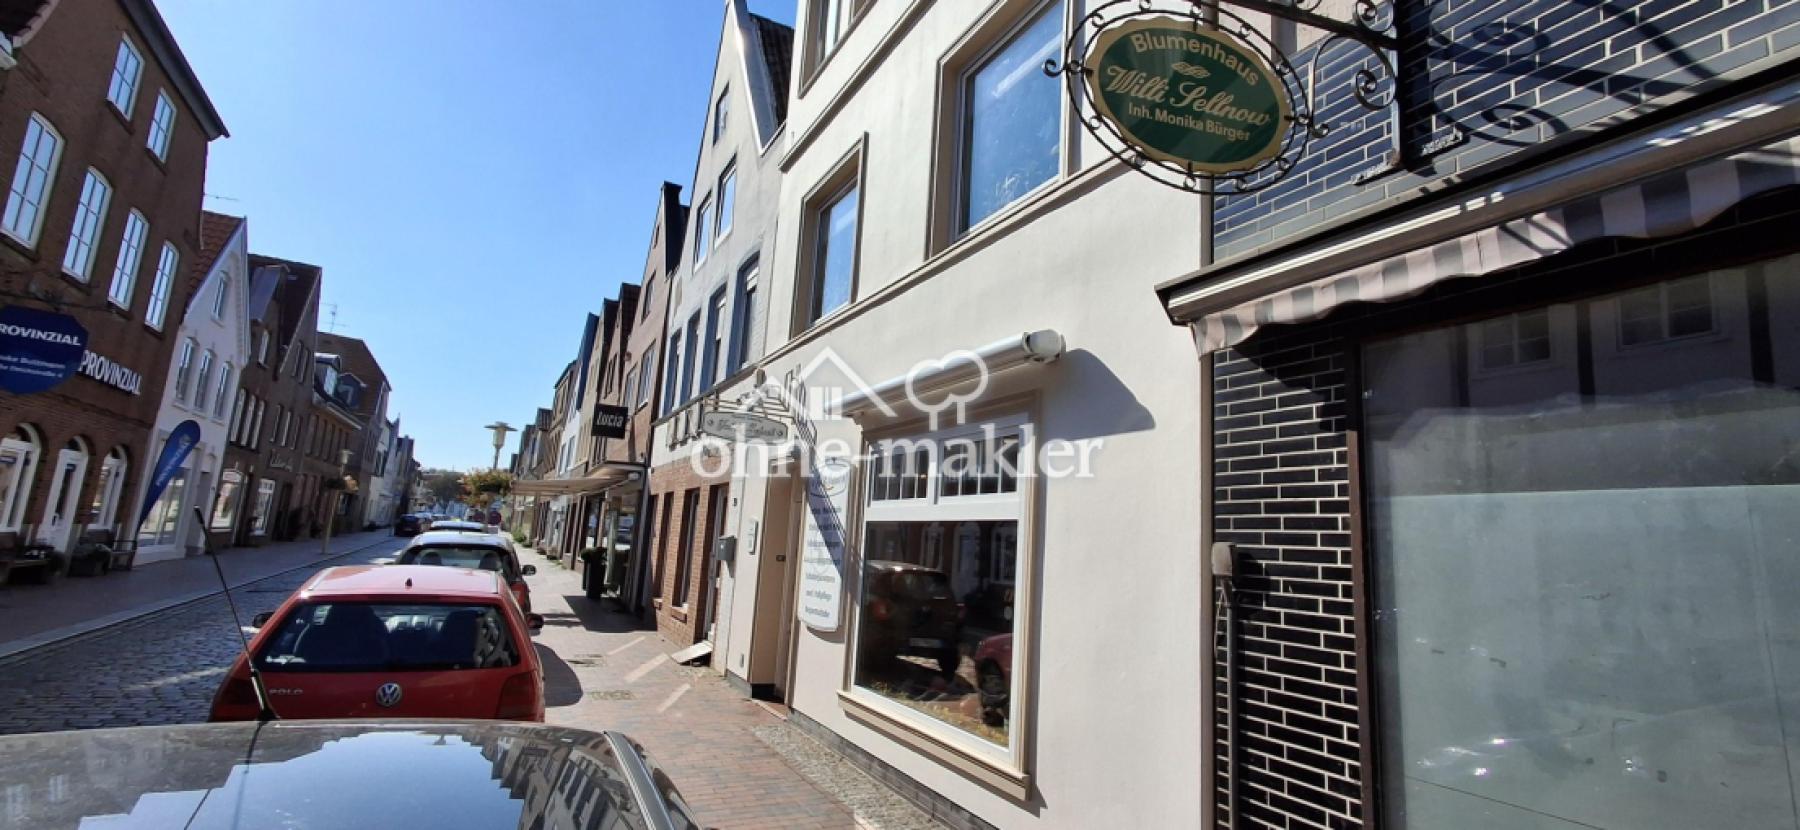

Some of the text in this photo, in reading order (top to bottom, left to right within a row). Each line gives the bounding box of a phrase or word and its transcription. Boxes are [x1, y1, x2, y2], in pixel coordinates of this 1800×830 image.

[1132, 32, 1258, 86] Blumenhaus
[1105, 65, 1271, 126] Willi Sellnow
[1128, 102, 1251, 142] Inh. Monika Bürger
[77, 349, 142, 396] PROVINZIAL
